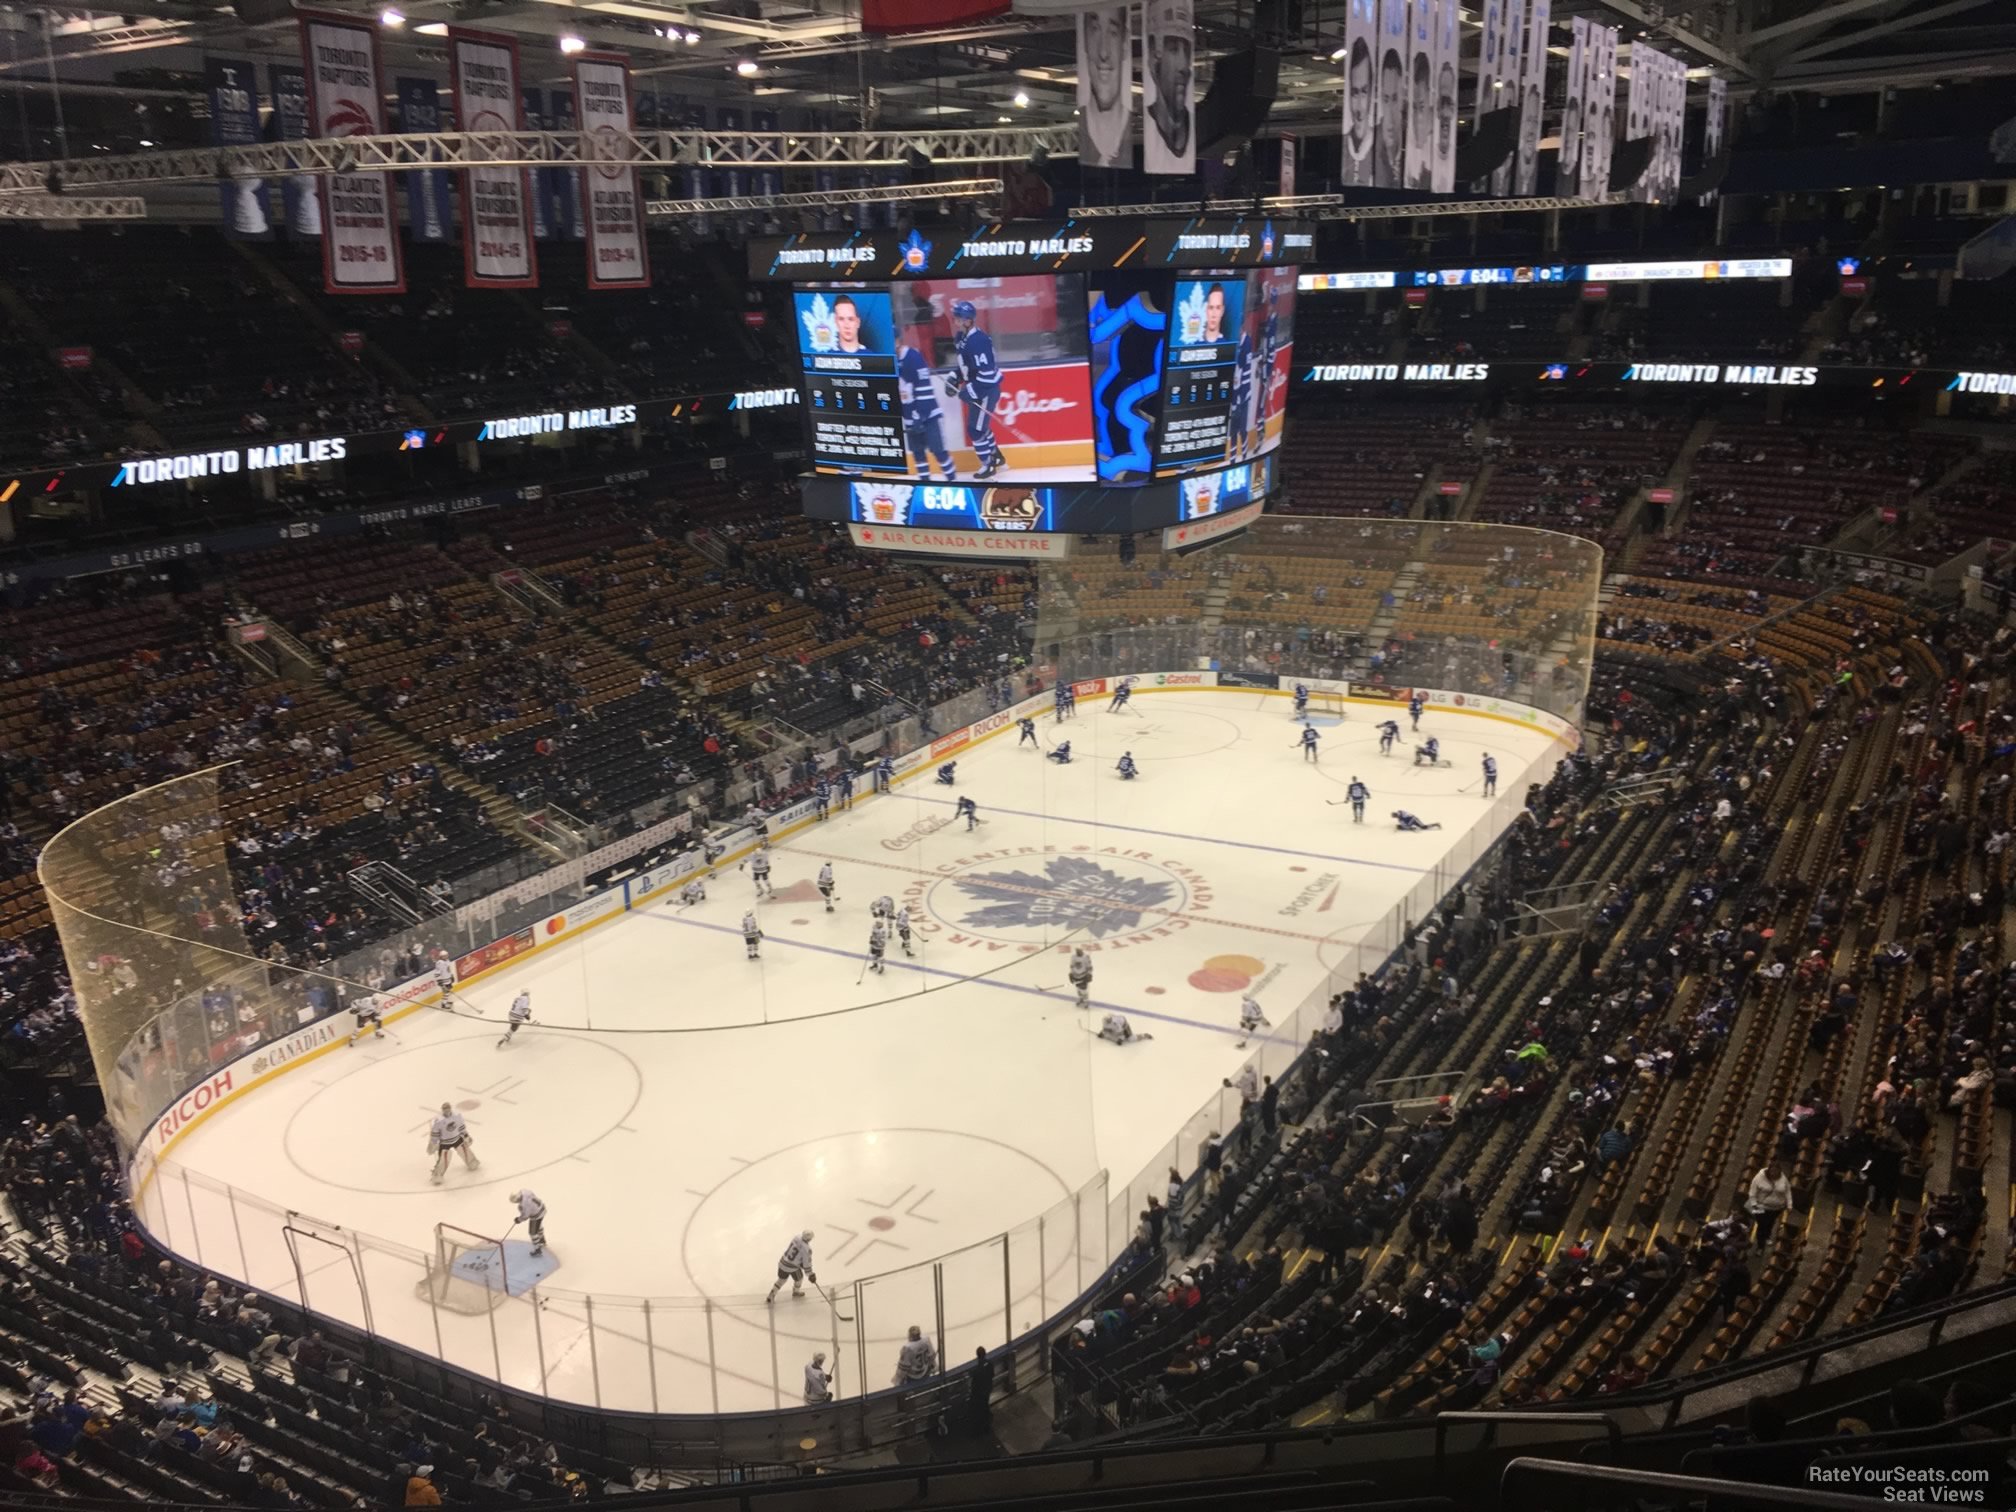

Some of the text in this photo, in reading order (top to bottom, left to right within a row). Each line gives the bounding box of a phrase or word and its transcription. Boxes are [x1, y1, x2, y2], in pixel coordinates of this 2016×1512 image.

[316, 45, 369, 68] TORONTO
[318, 65, 372, 88] RAPTORS
[462, 61, 508, 82] TORONTO
[464, 80, 510, 100] RAPTORS
[583, 80, 622, 98] TORONTO
[584, 97, 624, 115] RAPTORS
[331, 176, 381, 195] ATLANTIC
[333, 195, 383, 214] DIVISION
[475, 197, 517, 214] DIVISION
[594, 190, 632, 205] ATLANTIC
[595, 207, 633, 222] DIVISION
[480, 241, 521, 258] 2014-15
[962, 237, 1094, 257] TORONTO MARLIES
[1178, 234, 1250, 249] TORONTO MARLIES
[340, 245, 387, 262] 2015-16
[598, 248, 635, 262] 2013-14
[779, 247, 876, 265] TORONTO MARLIES
[1470, 269, 1499, 283] 6:04
[1313, 364, 1489, 381] TORONTO MARLIES
[1631, 363, 1817, 385] TORONTO MARLIES
[484, 405, 636, 441] TORONTO MARLIES
[817, 423, 846, 433] DRAFTED
[122, 438, 346, 485] TORONTO MARLIES
[923, 487, 966, 511] 6:04
[359, 497, 482, 525] TORONTO MAPLE LEAFS
[882, 532, 1049, 551] AIR CANADA CENTRE
[110, 542, 201, 566] GO LEAFS GO
[1167, 673, 1202, 685] Castrol
[1431, 694, 1447, 703] LG
[1467, 698, 1481, 707] LG
[973, 710, 1010, 737] RICOH
[880, 813, 956, 851] Coca-Cola
[936, 845, 1056, 872] CENTRE
[1027, 875, 1105, 919] TORONTO
[1057, 883, 1115, 916] MAPLE
[1057, 846, 1213, 954] AIR CANADA CENTRE
[948, 934, 1008, 951] AIR
[268, 1023, 336, 1067] CANADIAN
[158, 1070, 234, 1144] RICOH
[785, 1242, 799, 1262] 13
